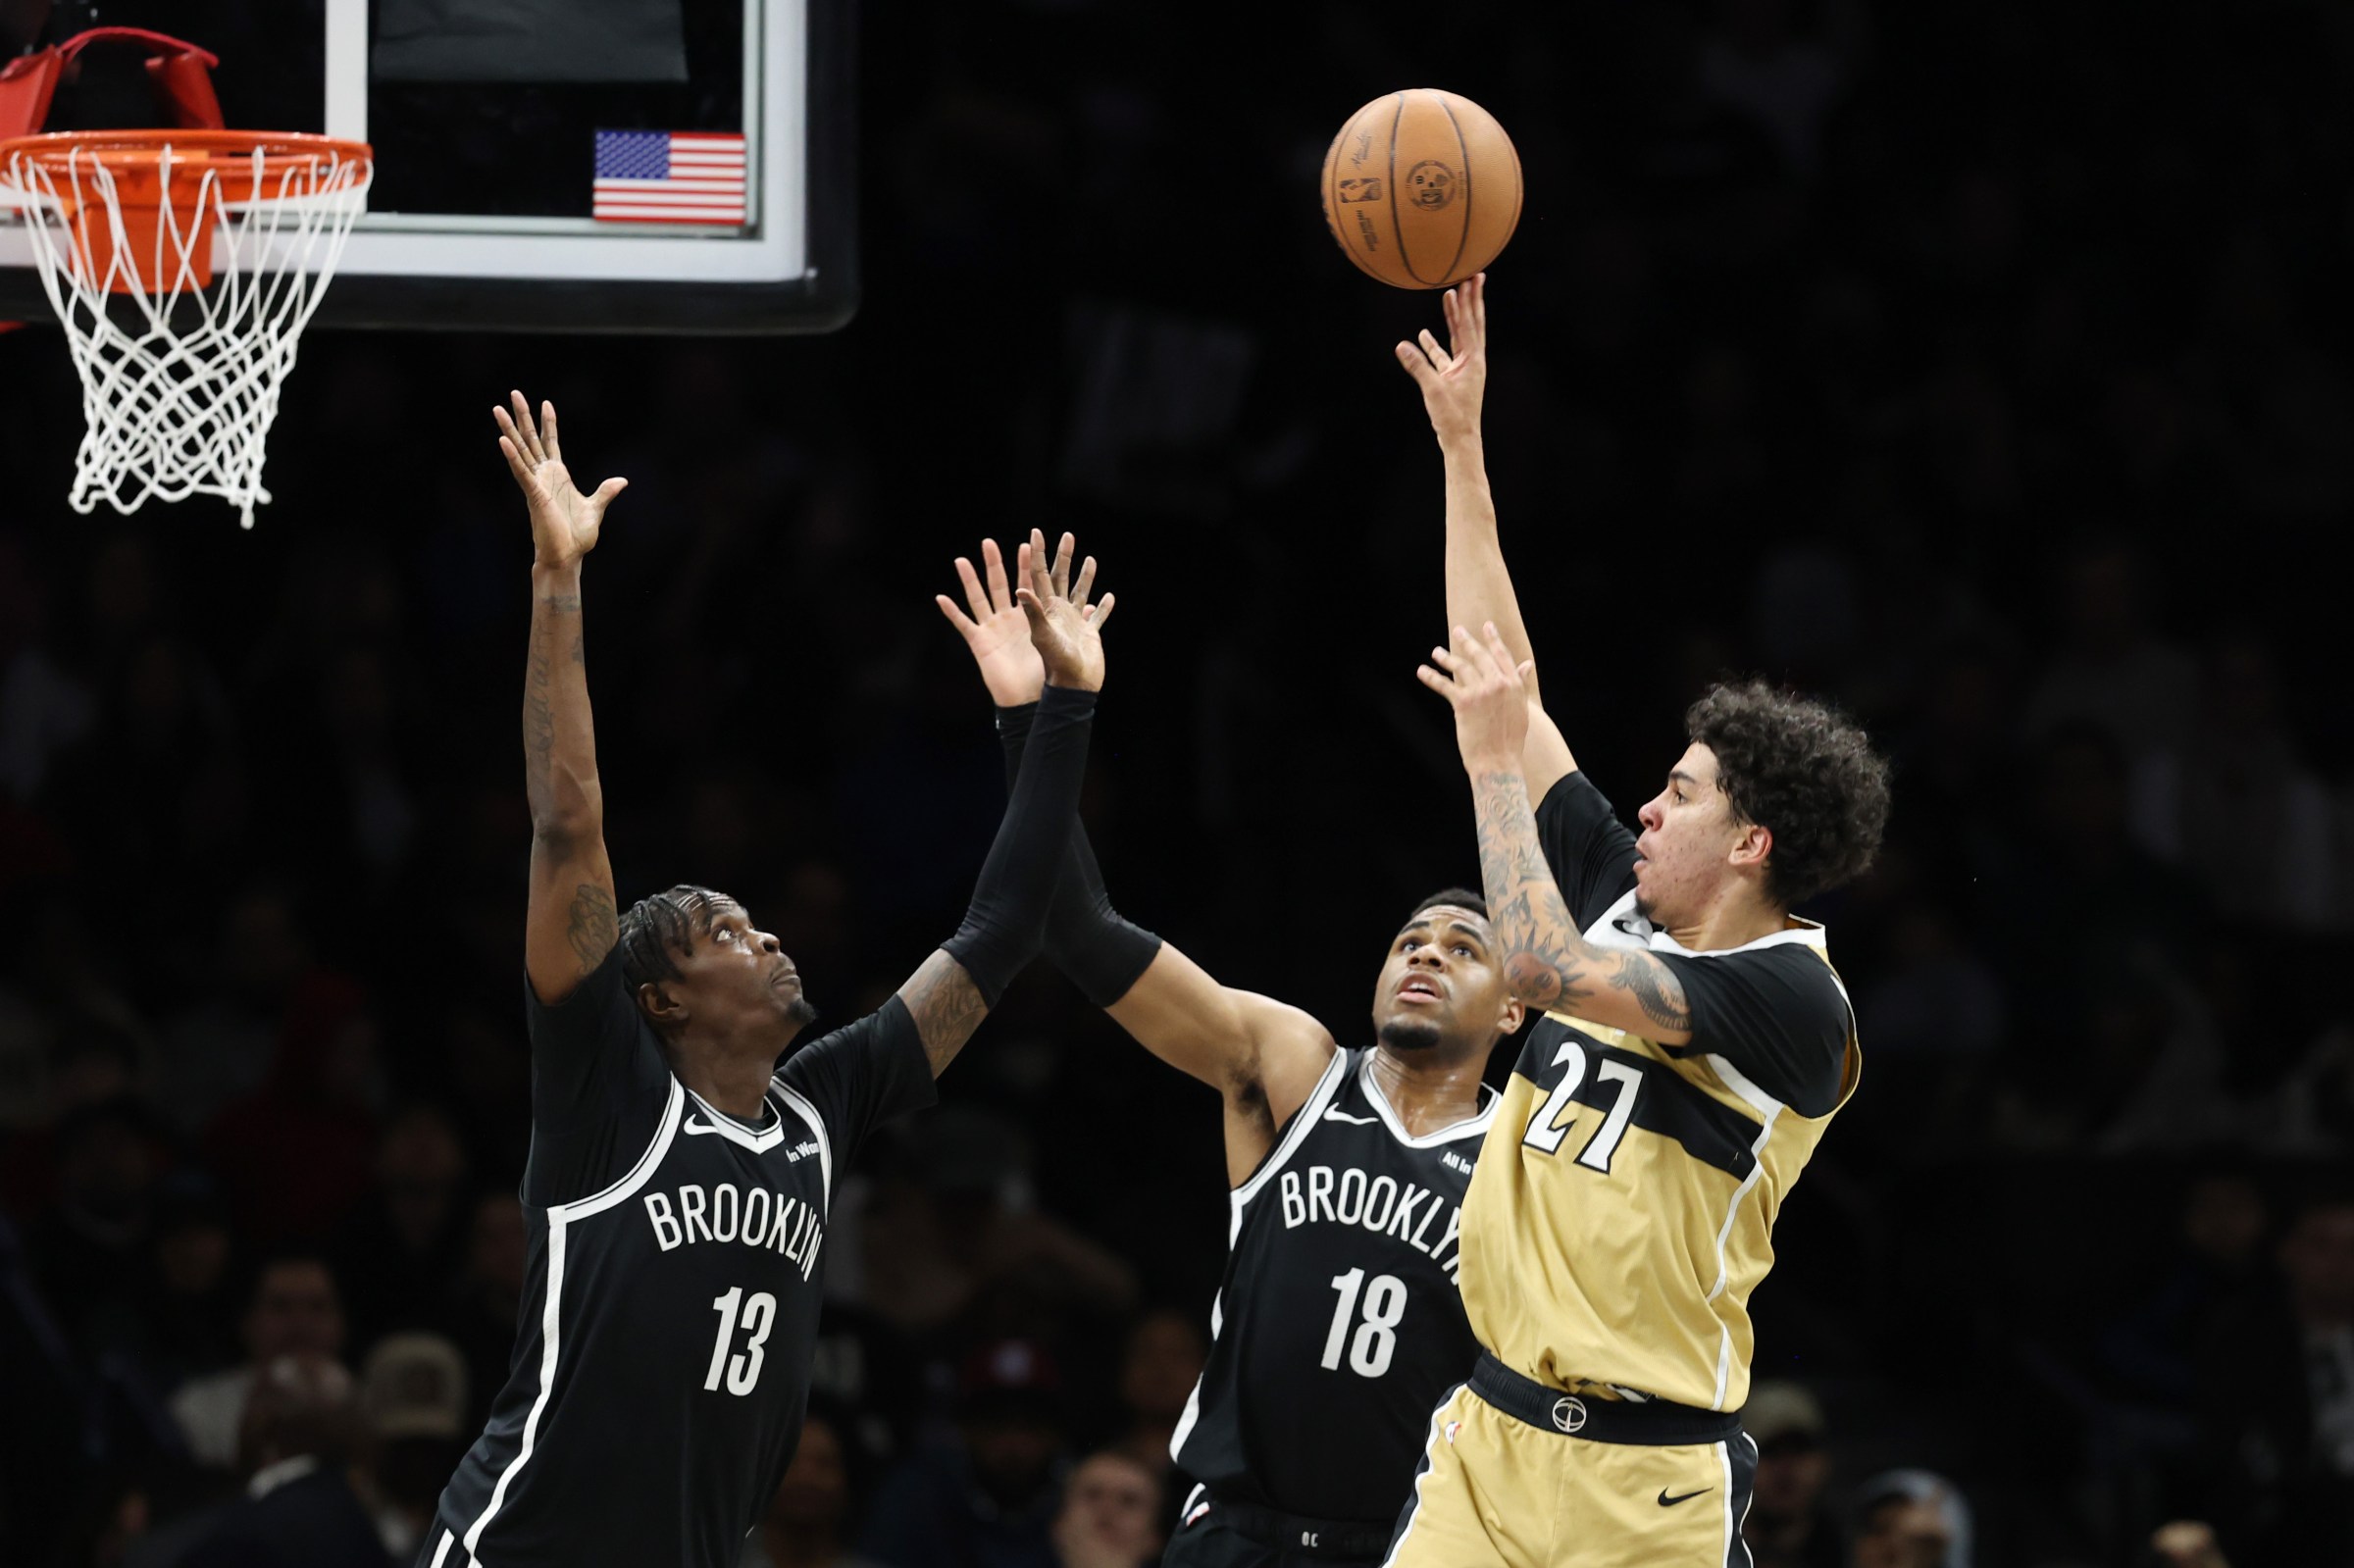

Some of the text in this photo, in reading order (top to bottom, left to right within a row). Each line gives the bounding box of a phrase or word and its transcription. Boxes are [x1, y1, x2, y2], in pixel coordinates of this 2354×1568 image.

[1442, 1150, 1460, 1169] All
[1458, 1158, 1472, 1175] In
[1521, 1040, 1644, 1175] 27
[643, 1183, 823, 1283] BROOKLYN
[703, 1286, 777, 1396] 13
[1320, 1267, 1408, 1379] 18
